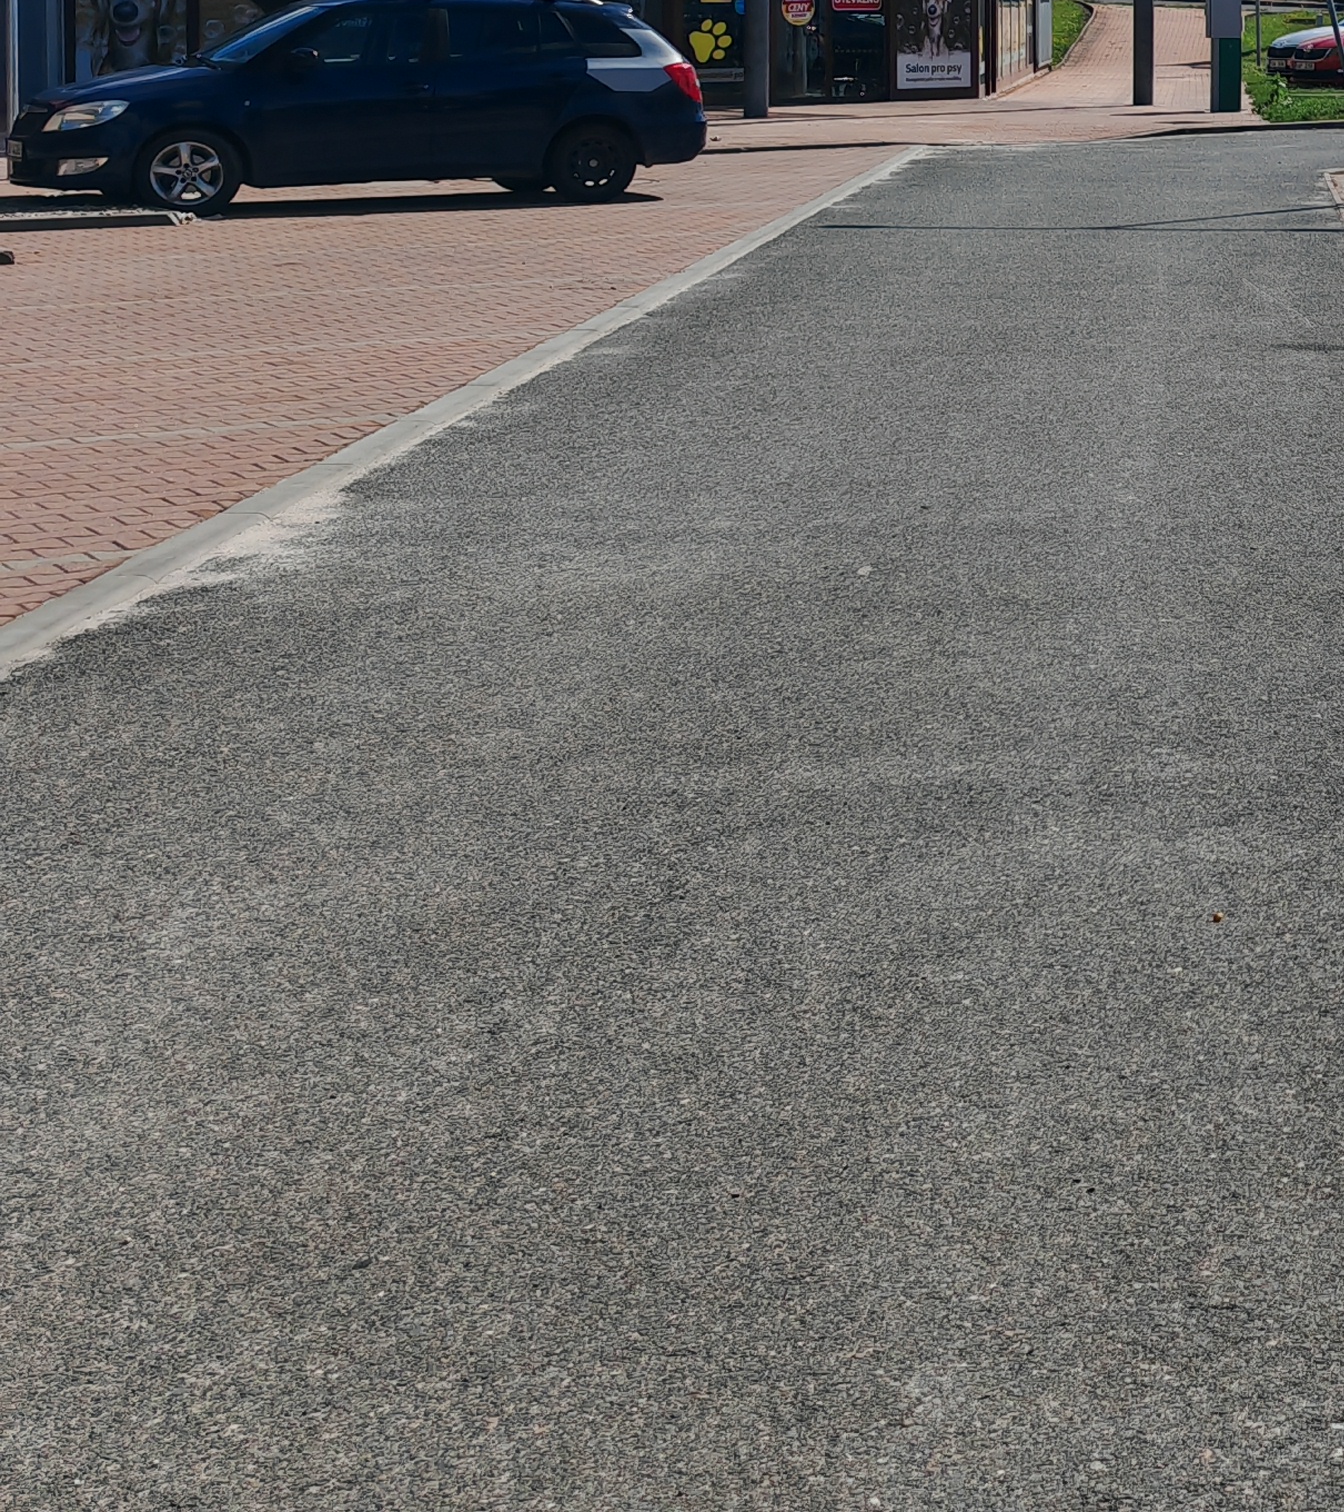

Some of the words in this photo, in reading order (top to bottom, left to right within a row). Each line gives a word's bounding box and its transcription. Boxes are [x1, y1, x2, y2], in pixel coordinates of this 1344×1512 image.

[905, 63, 930, 73] Salon
[931, 64, 946, 75] pro
[946, 64, 962, 75] psy
